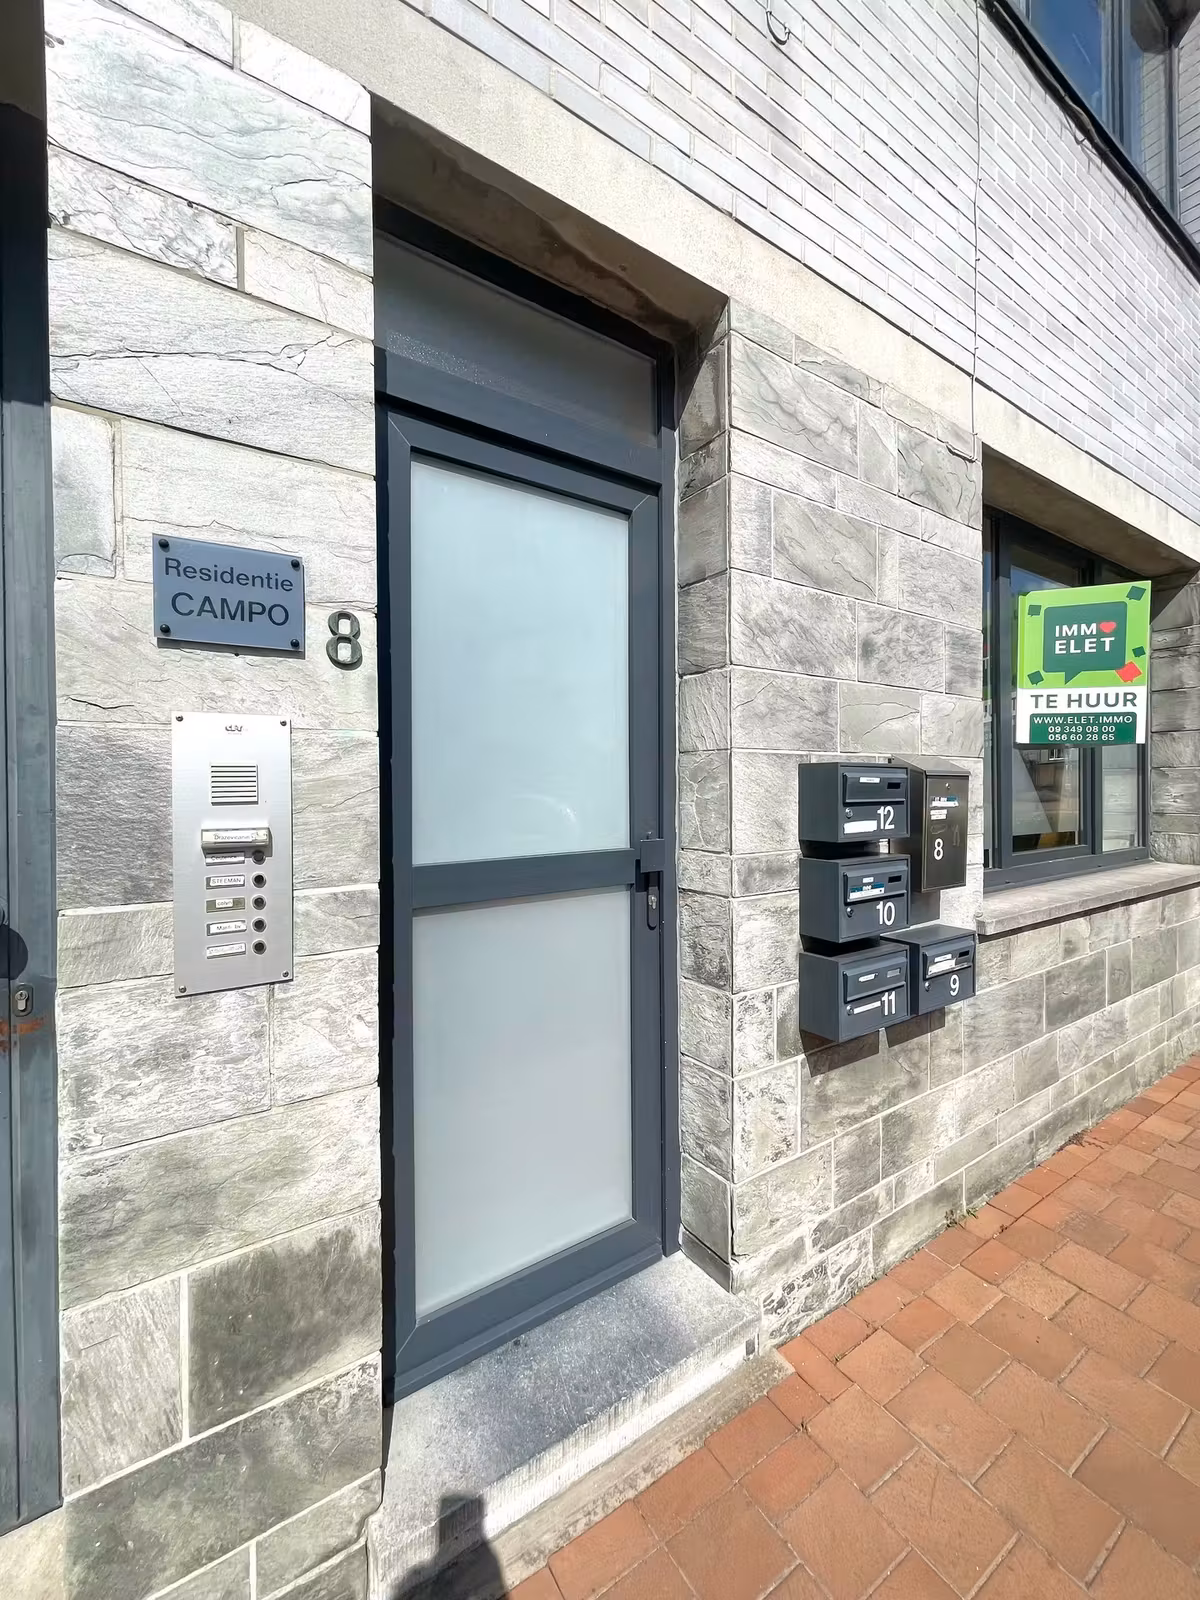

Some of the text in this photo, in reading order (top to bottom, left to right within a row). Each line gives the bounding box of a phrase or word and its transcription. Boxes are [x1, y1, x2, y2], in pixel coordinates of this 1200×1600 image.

[164, 557, 294, 592] Residentie
[171, 591, 290, 626] CAMPO
[326, 610, 362, 665] 8
[1054, 637, 1115, 654] ELET
[1030, 692, 1137, 709] TE HUUR
[1033, 715, 1133, 724] WWW.ELET.IMMO
[1085, 725, 1099, 733] 08
[1101, 725, 1116, 733] 00
[1070, 733, 1083, 741] 60
[1086, 733, 1099, 741] 28
[1101, 733, 1115, 741] 65
[877, 805, 895, 830] 12
[933, 838, 944, 860] 8
[876, 901, 896, 926] 10
[949, 974, 960, 996] 9
[881, 990, 896, 1016] 11
